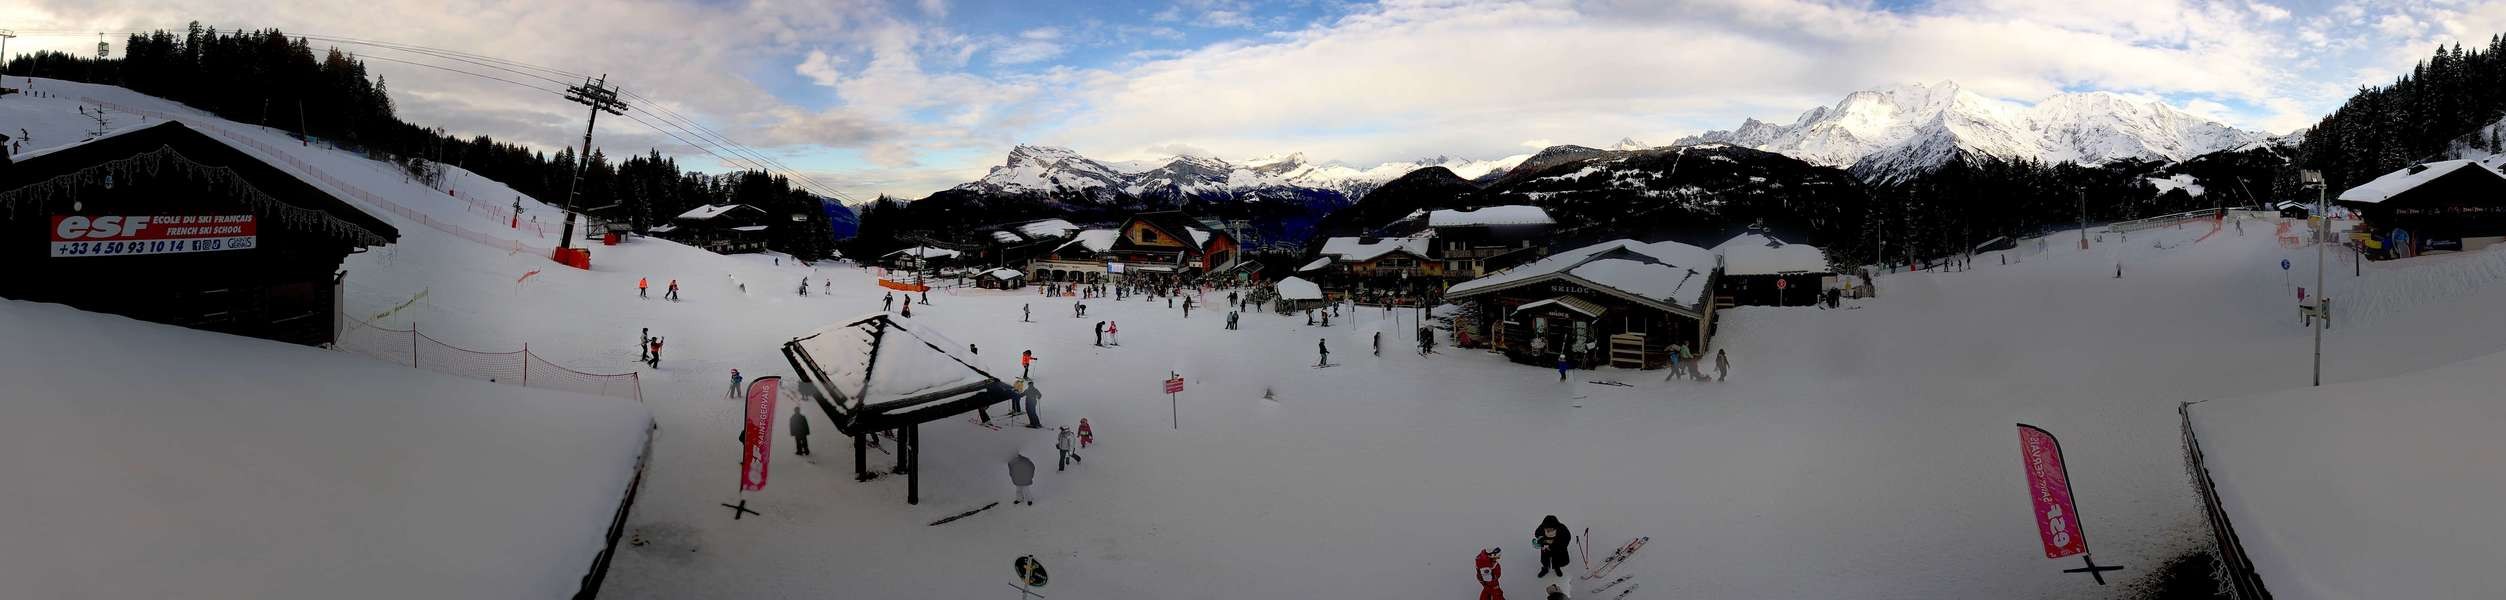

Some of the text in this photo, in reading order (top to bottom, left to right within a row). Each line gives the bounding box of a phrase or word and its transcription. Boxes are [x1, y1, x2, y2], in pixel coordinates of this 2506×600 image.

[183, 216, 196, 224] DU
[198, 215, 211, 223] SKI
[167, 226, 242, 236] FRENCH SKI SCHOOL
[60, 240, 185, 255] +33 4 50 93 10 14
